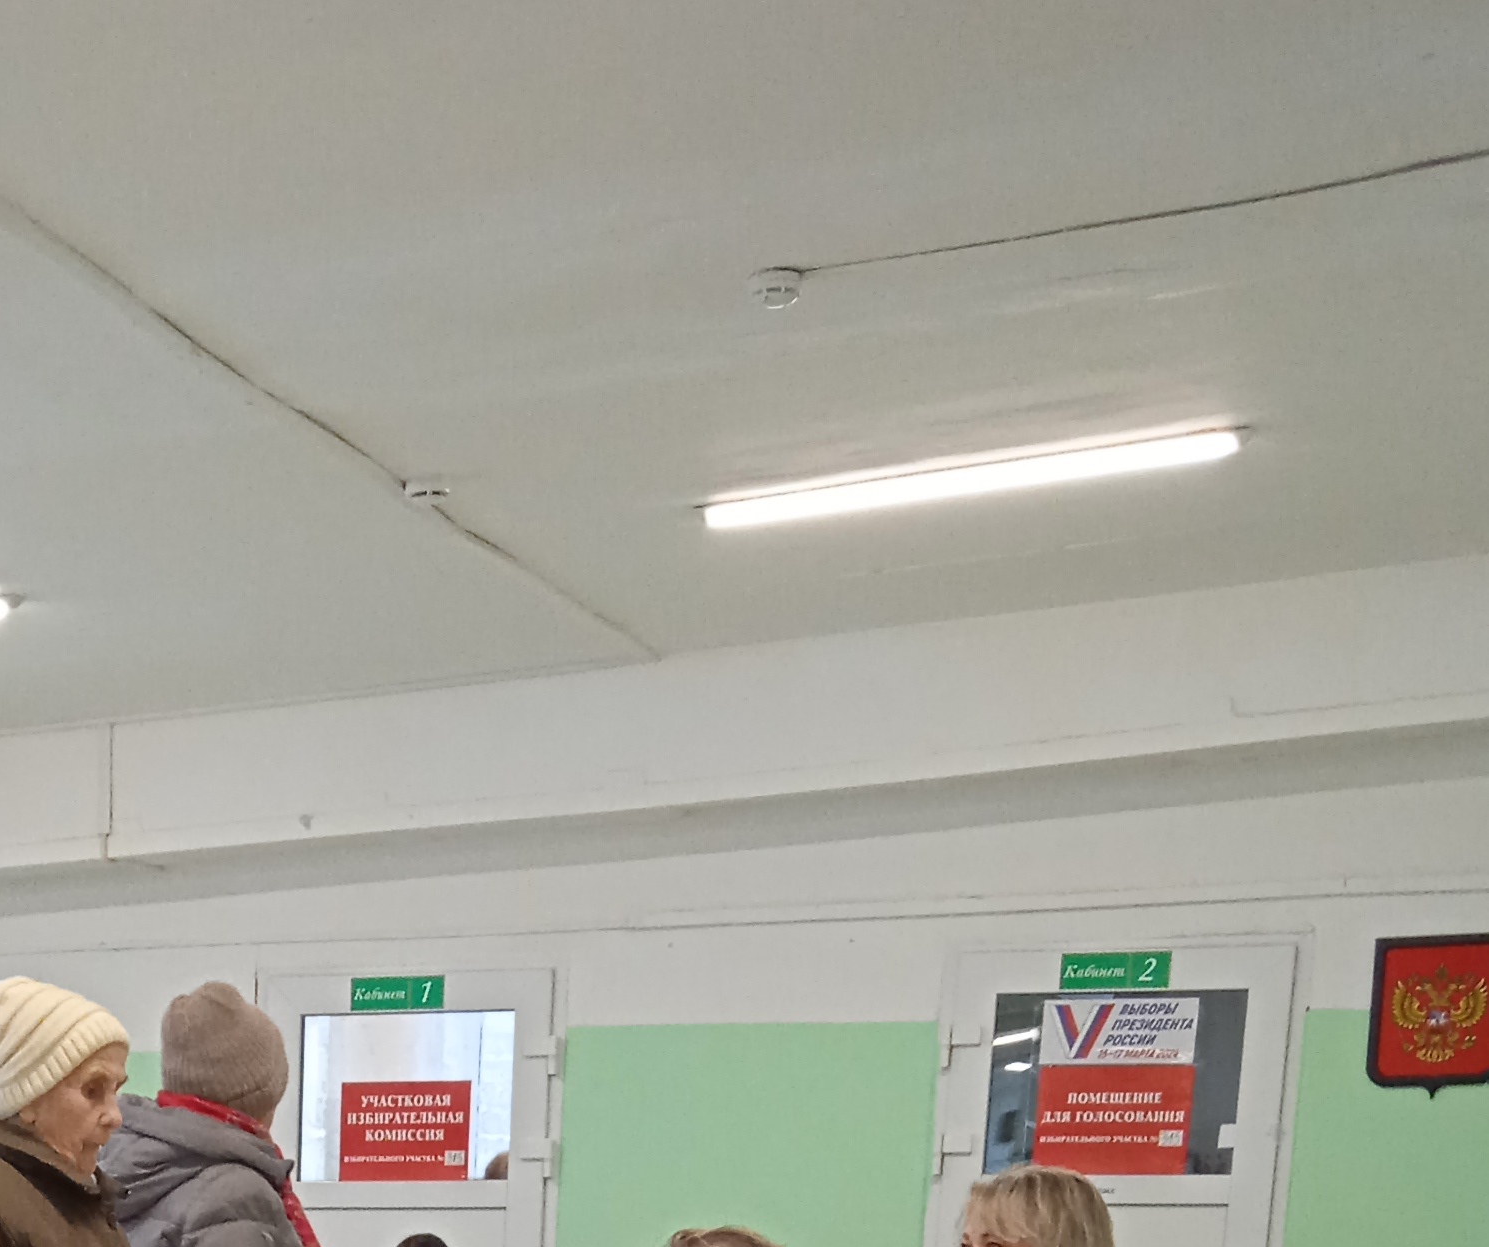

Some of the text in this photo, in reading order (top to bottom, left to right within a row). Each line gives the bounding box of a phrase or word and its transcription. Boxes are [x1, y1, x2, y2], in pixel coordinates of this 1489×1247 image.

[1063, 957, 1158, 982] Кабинет 2
[353, 981, 432, 1003] Кабинет 1
[1119, 1002, 1179, 1015] ВЫБОРЫ
[1111, 1018, 1194, 1031] ПРЕЗИДЕНТА
[1103, 1034, 1157, 1046] РОССИИ
[1124, 1049, 1155, 1058] МАРТА
[361, 1095, 451, 1108] УЧАСТКОВАЯ
[1067, 1092, 1162, 1105] ПОМЕЩЕНИЕ
[347, 1112, 464, 1126] ИЗБИРАТЕЛЬНАЯ
[1041, 1110, 1185, 1125] ДЛЯ ГОЛОСОВАНИЯ
[365, 1129, 445, 1142] КОМИССИЯ
